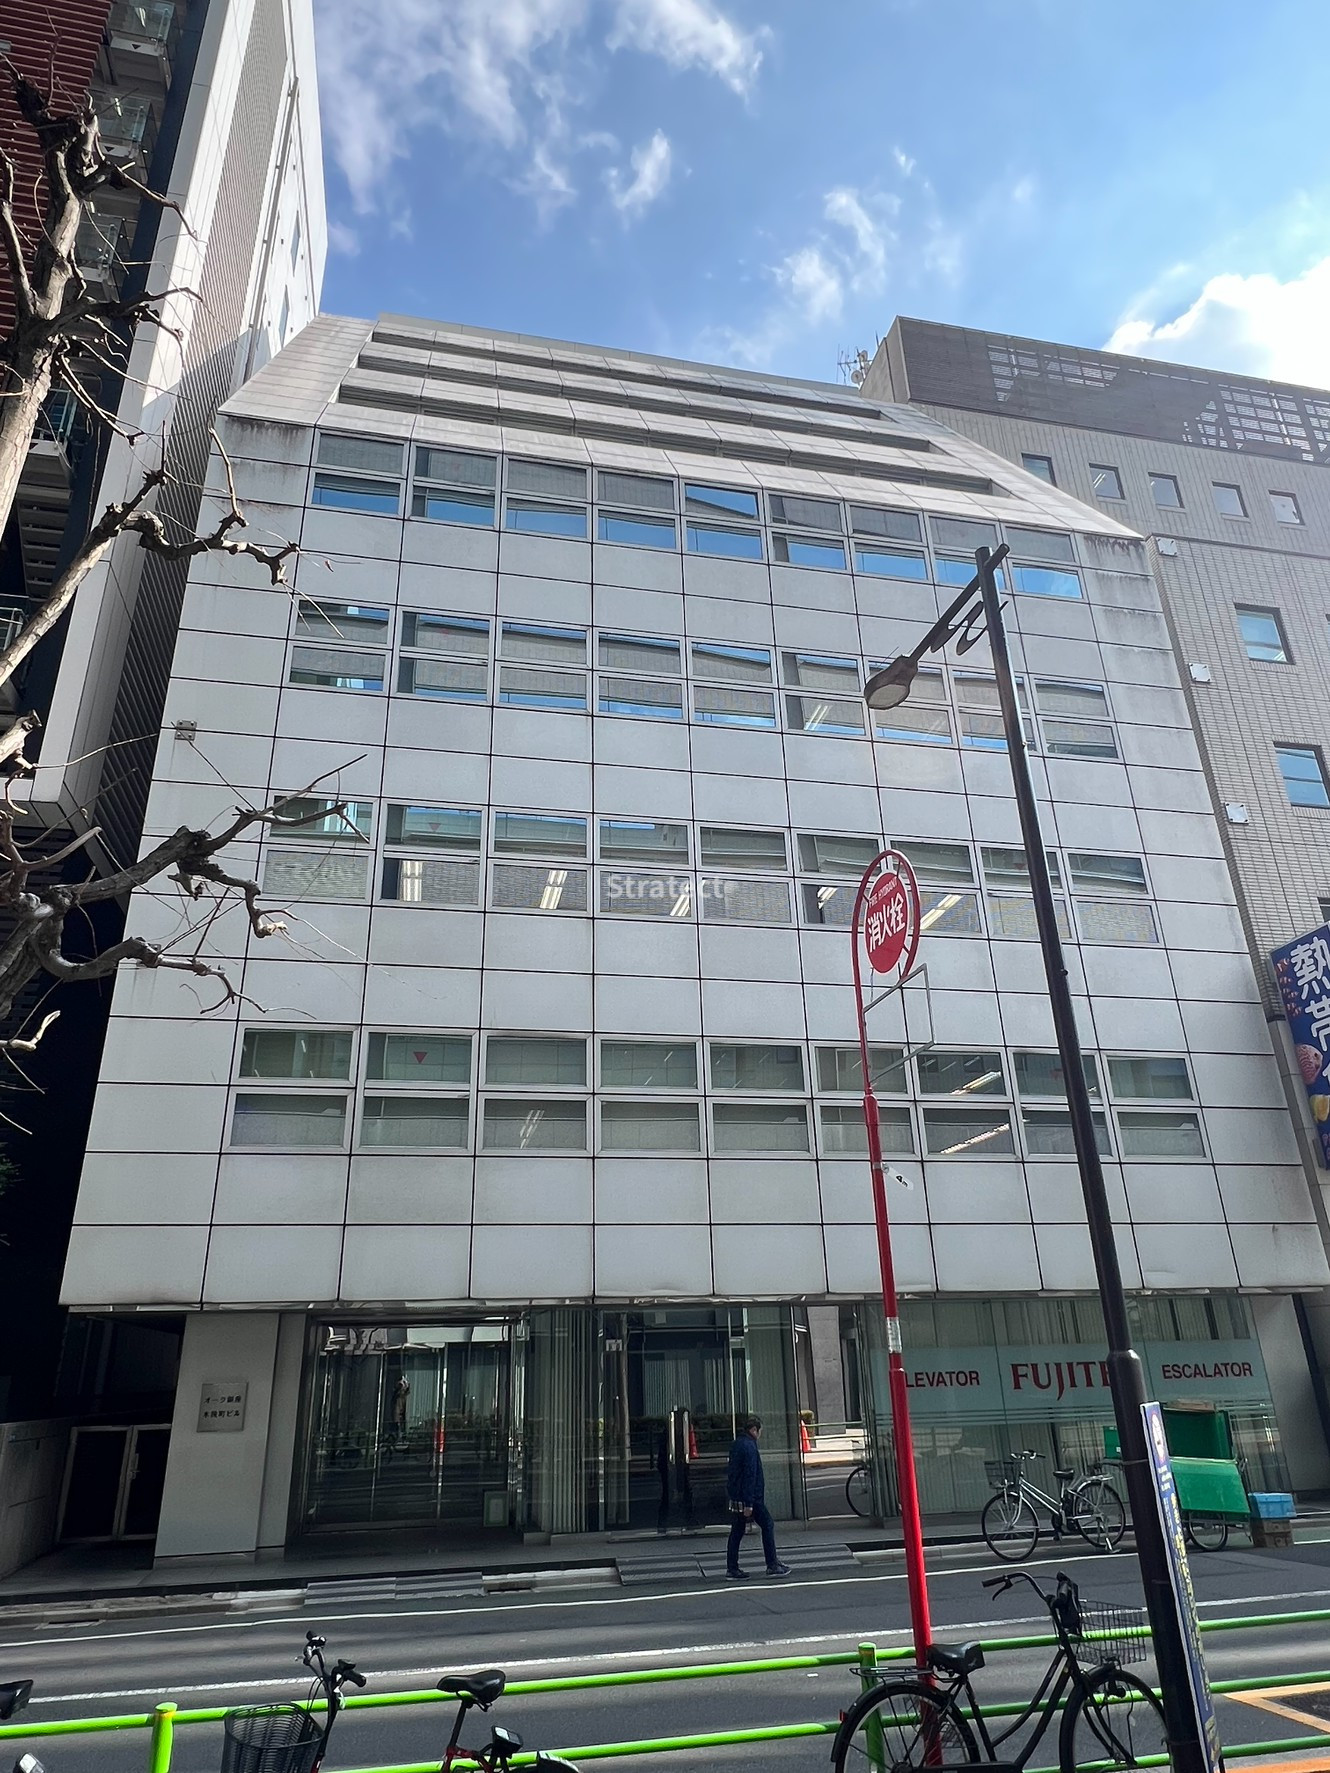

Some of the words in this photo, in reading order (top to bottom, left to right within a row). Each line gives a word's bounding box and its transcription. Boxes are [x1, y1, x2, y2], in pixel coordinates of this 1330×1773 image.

[867, 892, 905, 953] 消火栓
[1290, 936, 1330, 1089] 熱帯
[904, 1370, 980, 1388] LEVATOR
[1161, 1362, 1254, 1380] ESCALATOR
